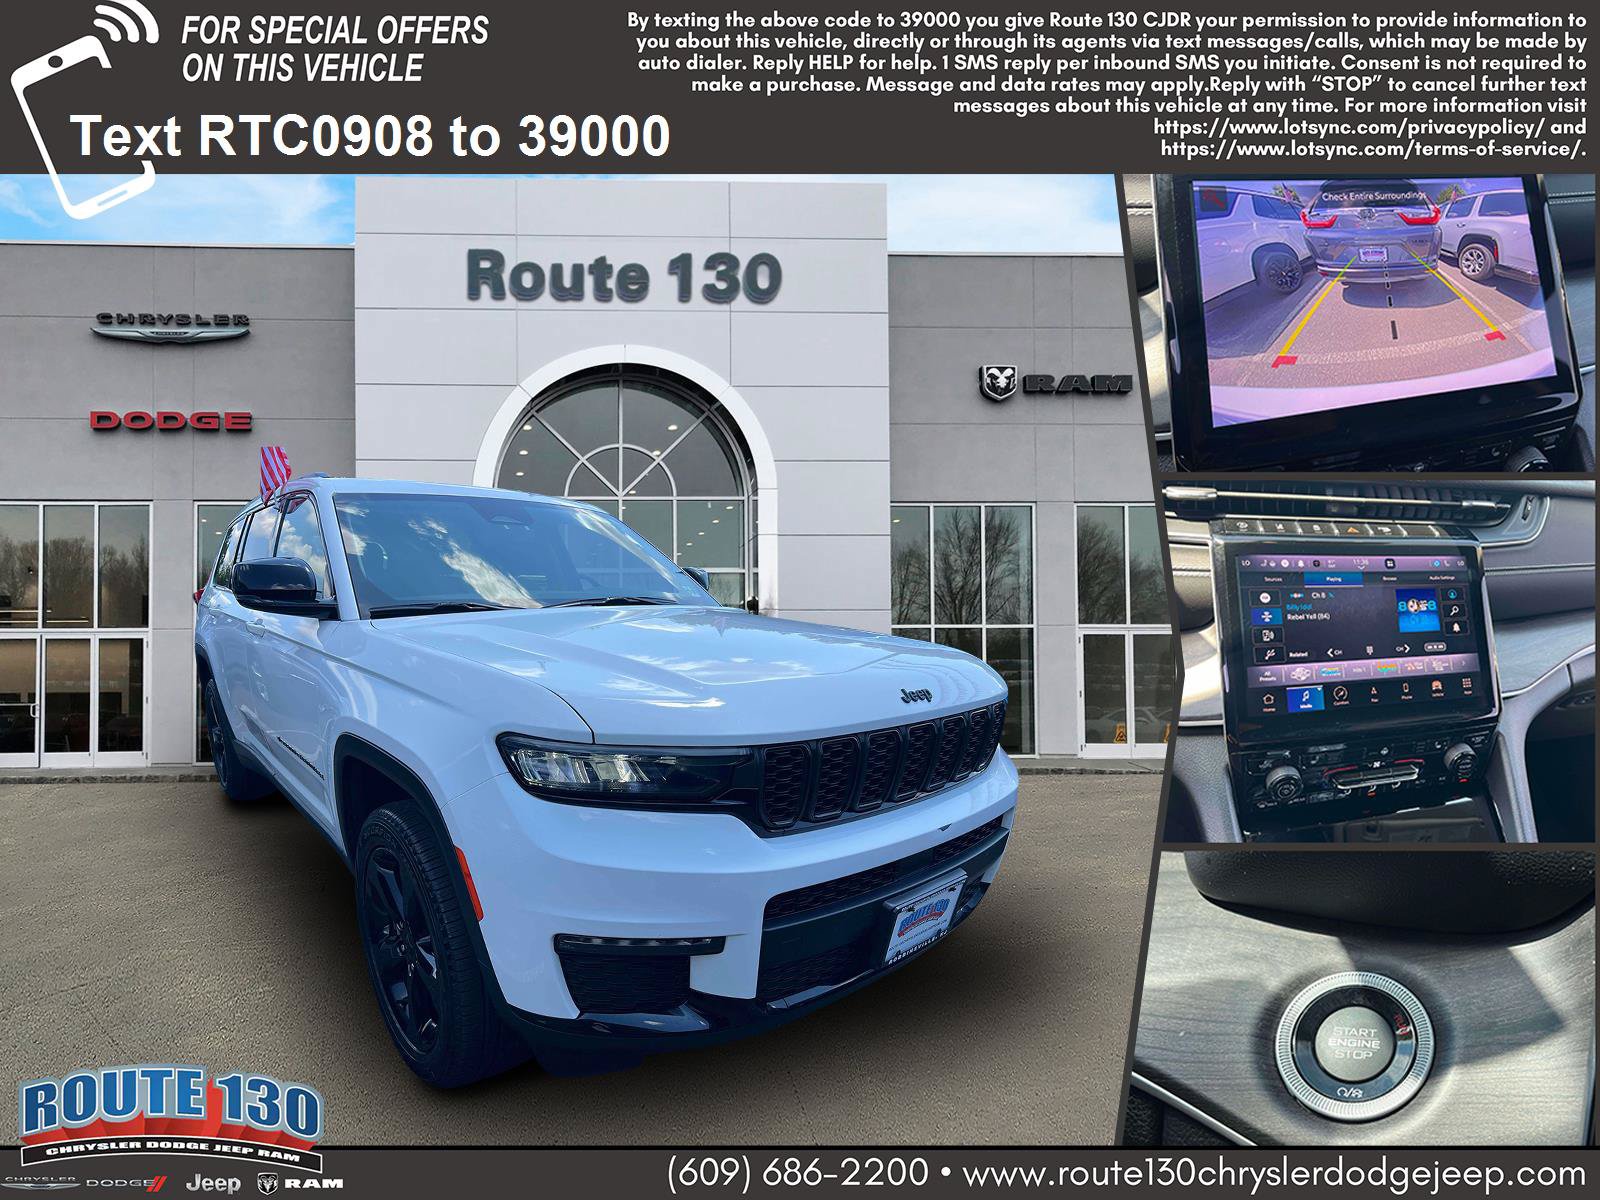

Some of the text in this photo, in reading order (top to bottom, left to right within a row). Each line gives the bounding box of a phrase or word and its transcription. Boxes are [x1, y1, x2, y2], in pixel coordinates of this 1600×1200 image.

[1322, 192, 1427, 201] Check Entire Surroundings
[466, 248, 783, 305] Route 130
[96, 313, 250, 326] CHRYSLER
[1022, 374, 1133, 394] RAM
[89, 410, 253, 432] DODGE
[1306, 612, 1316, 620] Yell
[901, 687, 933, 705] Jeep
[1333, 1026, 1378, 1038] START
[1327, 1038, 1381, 1049] ENGINE
[1334, 1049, 1373, 1060] STOP
